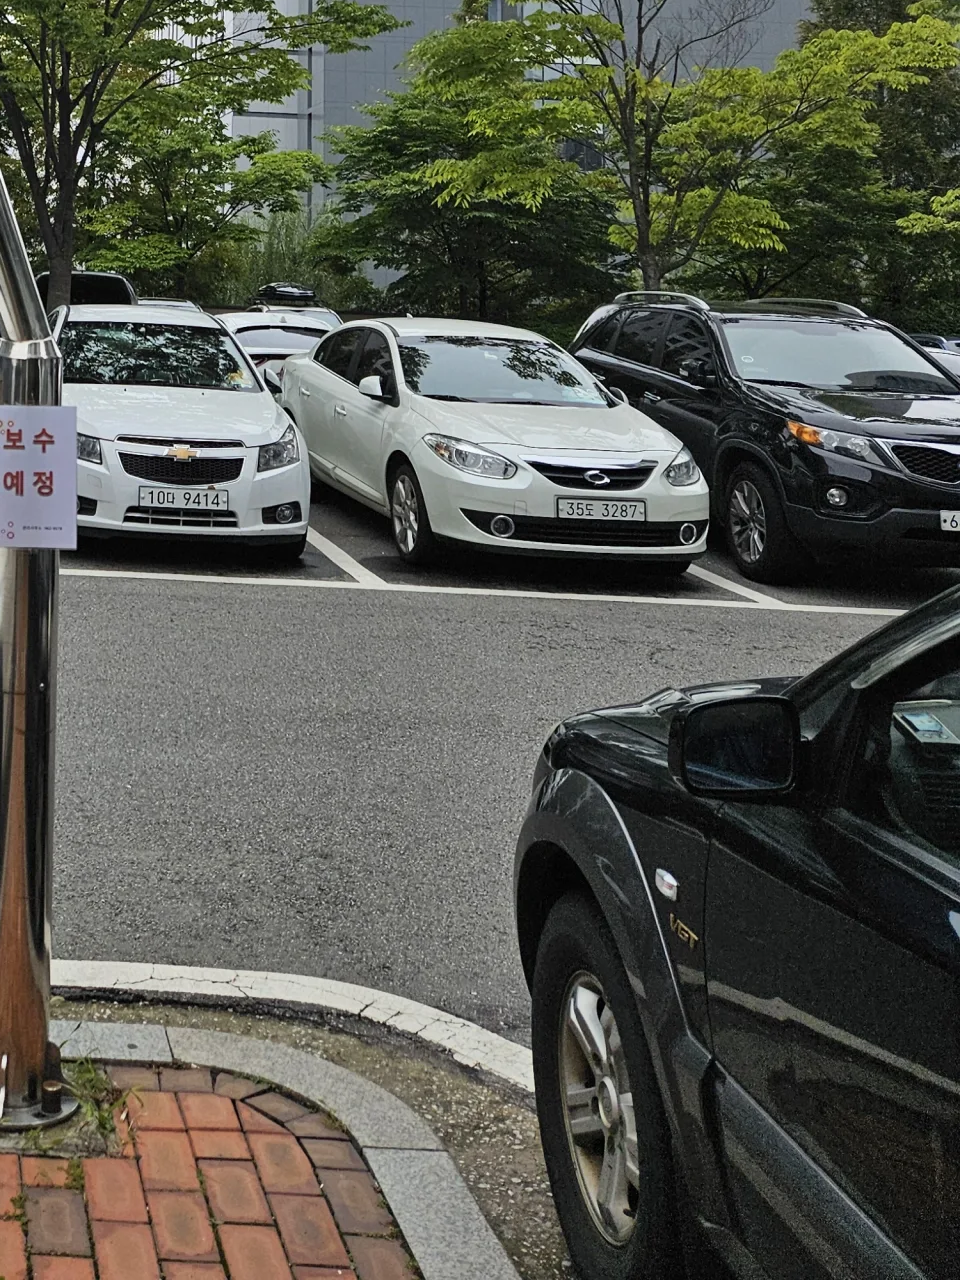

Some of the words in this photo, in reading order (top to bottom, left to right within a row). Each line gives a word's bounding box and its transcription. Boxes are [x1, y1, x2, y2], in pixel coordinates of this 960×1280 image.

[3, 428, 55, 453] 보수
[3, 470, 54, 497] 예정
[148, 490, 175, 505] 10다
[183, 492, 220, 507] 9414
[566, 501, 594, 516] 35도
[601, 503, 638, 518] 3287
[669, 912, 699, 948] VGT
